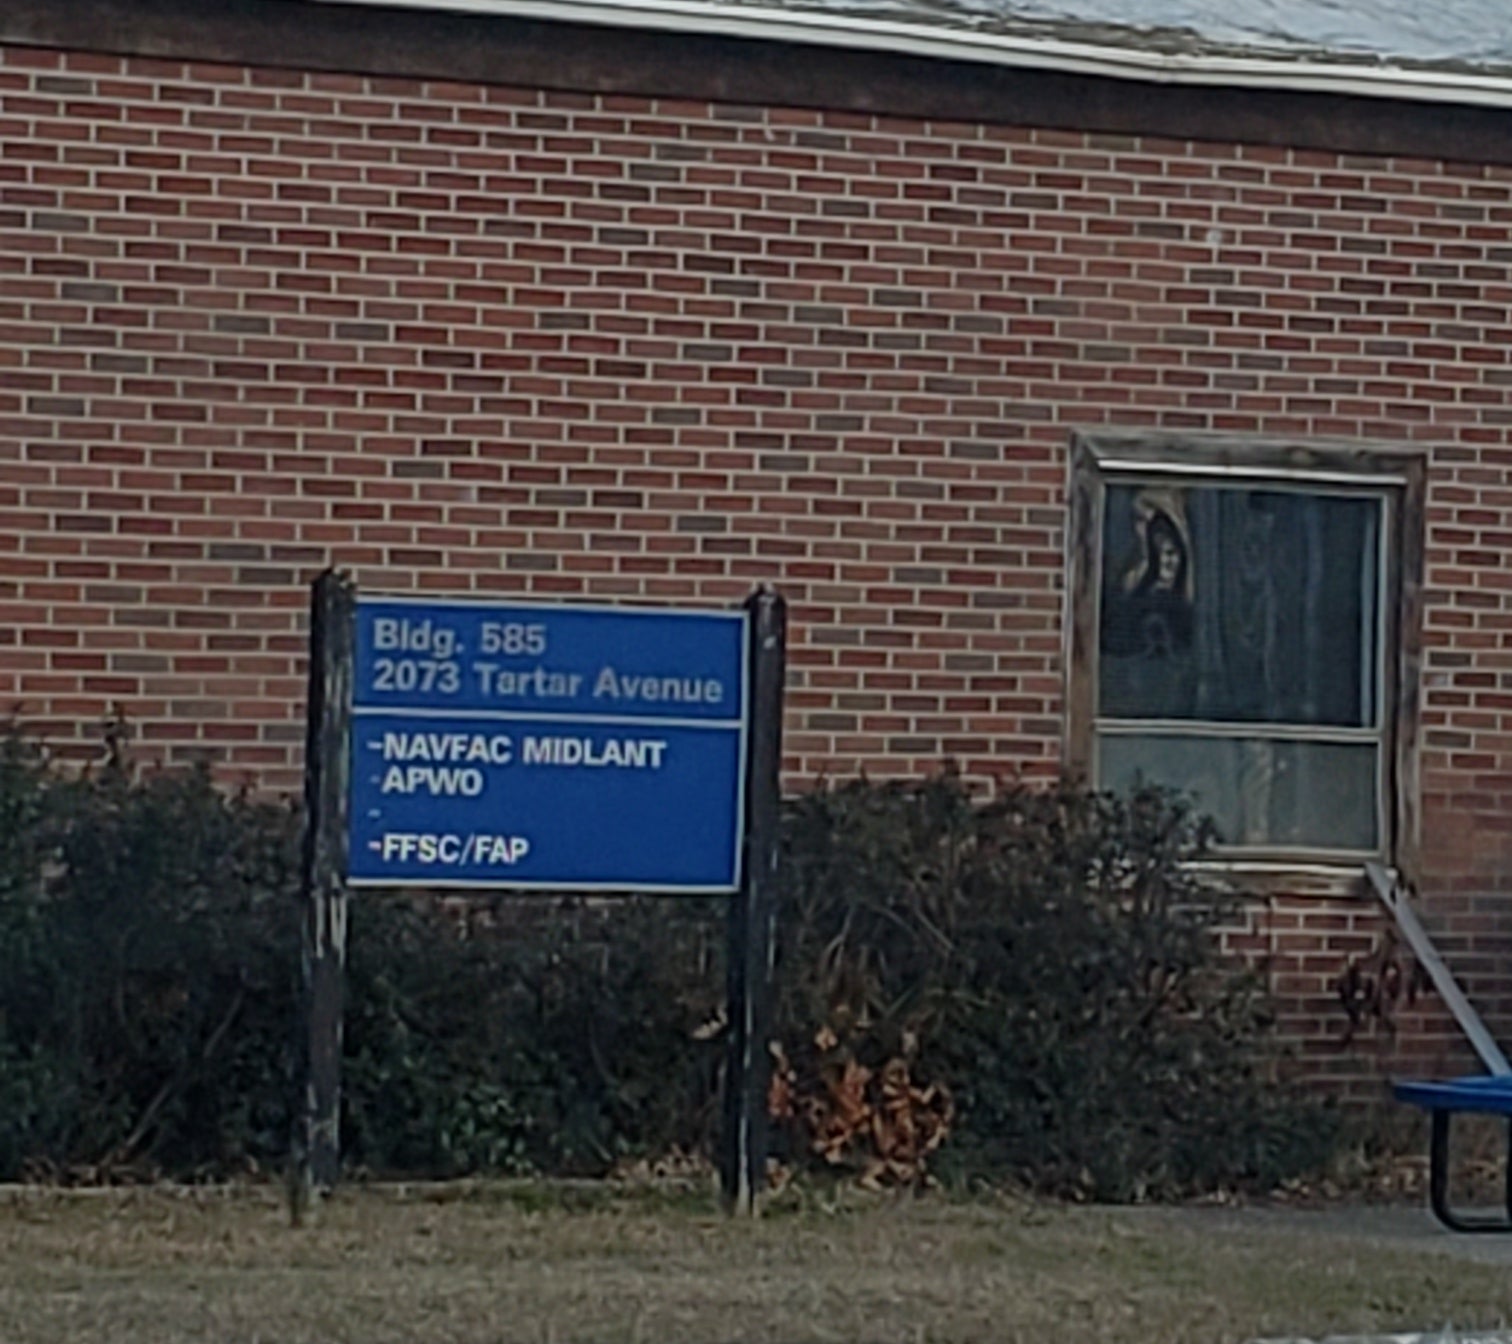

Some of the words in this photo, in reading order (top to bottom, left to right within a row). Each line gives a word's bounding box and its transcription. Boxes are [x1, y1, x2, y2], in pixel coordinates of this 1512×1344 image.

[373, 618, 464, 658] Bldg.
[480, 622, 546, 654] 585
[372, 660, 461, 693] 2073
[472, 663, 582, 698] Tartar
[592, 667, 724, 703] Avenue
[522, 737, 667, 769] MIDLANT
